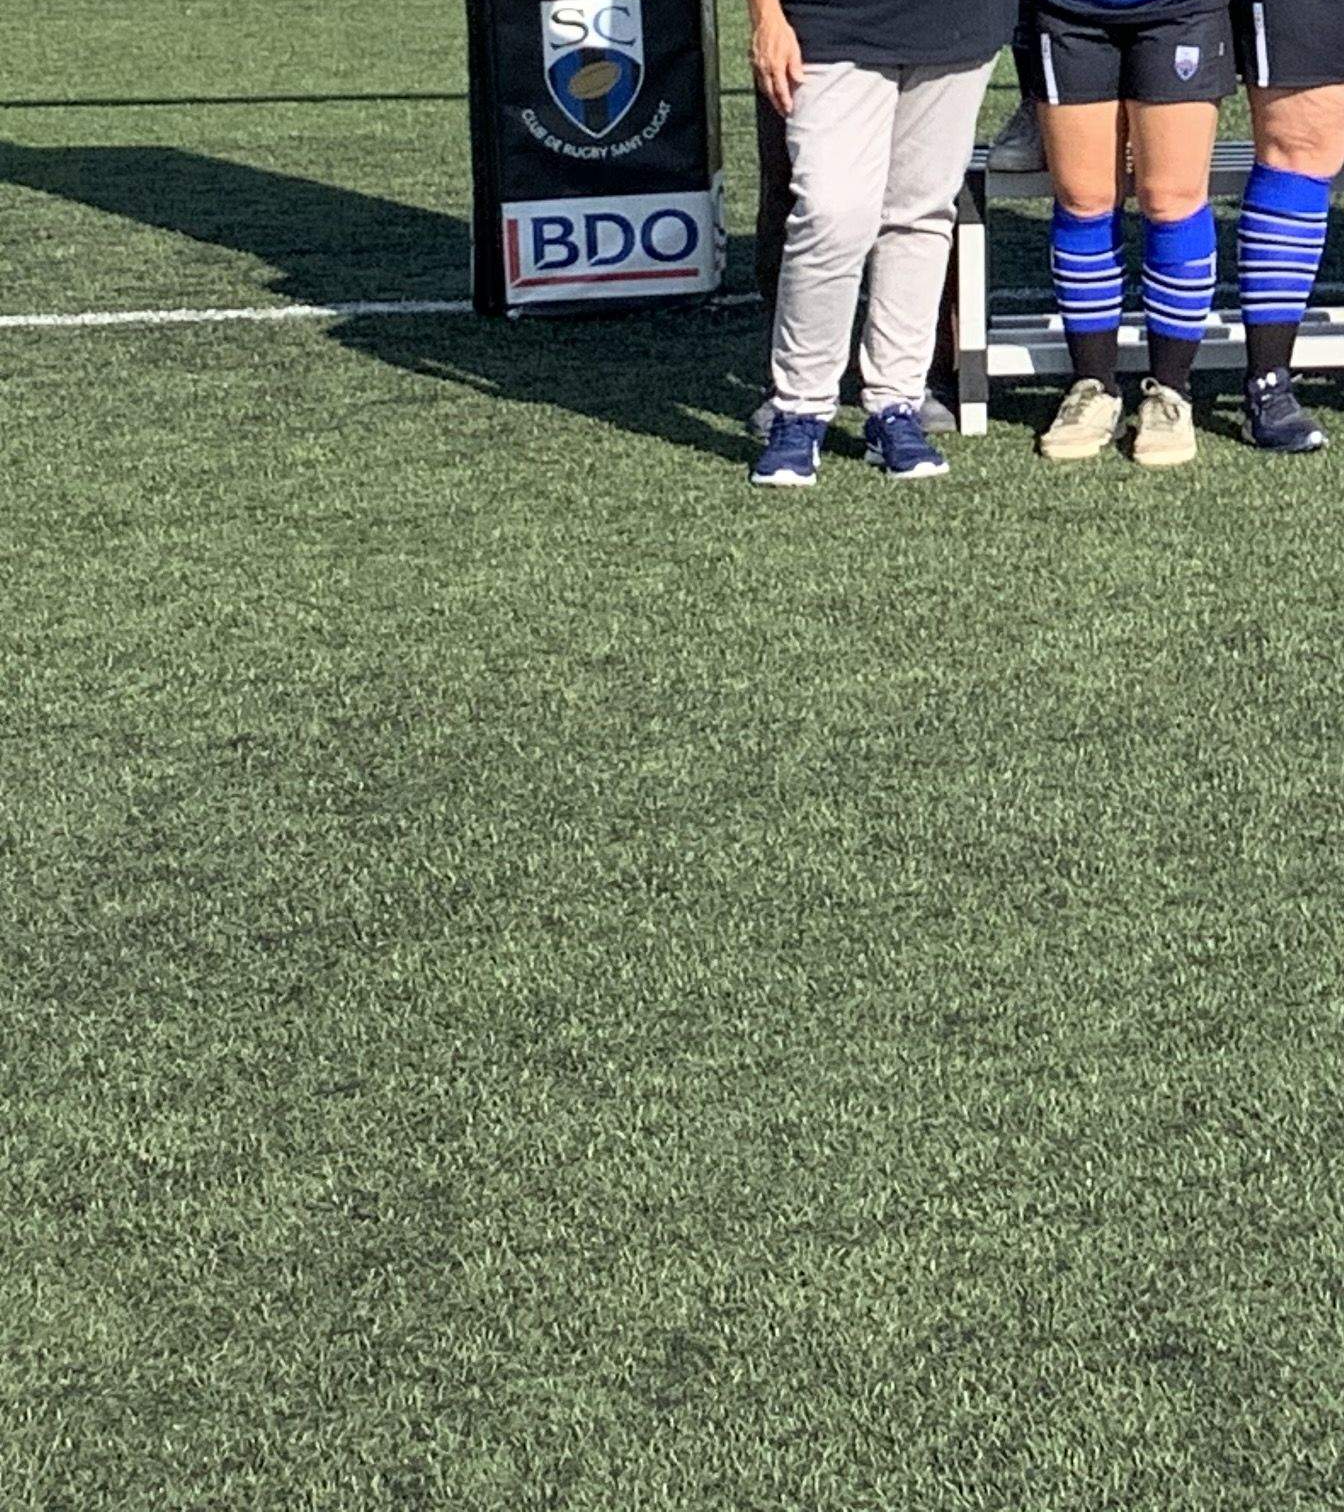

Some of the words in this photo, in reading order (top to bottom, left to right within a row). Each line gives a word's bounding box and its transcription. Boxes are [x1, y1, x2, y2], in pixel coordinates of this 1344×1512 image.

[551, 6, 636, 51] SC
[521, 108, 548, 138] CLUB
[544, 135, 563, 153] DE
[562, 144, 608, 160] RUGBY
[610, 135, 643, 157] SANT
[531, 209, 699, 268] BDO
